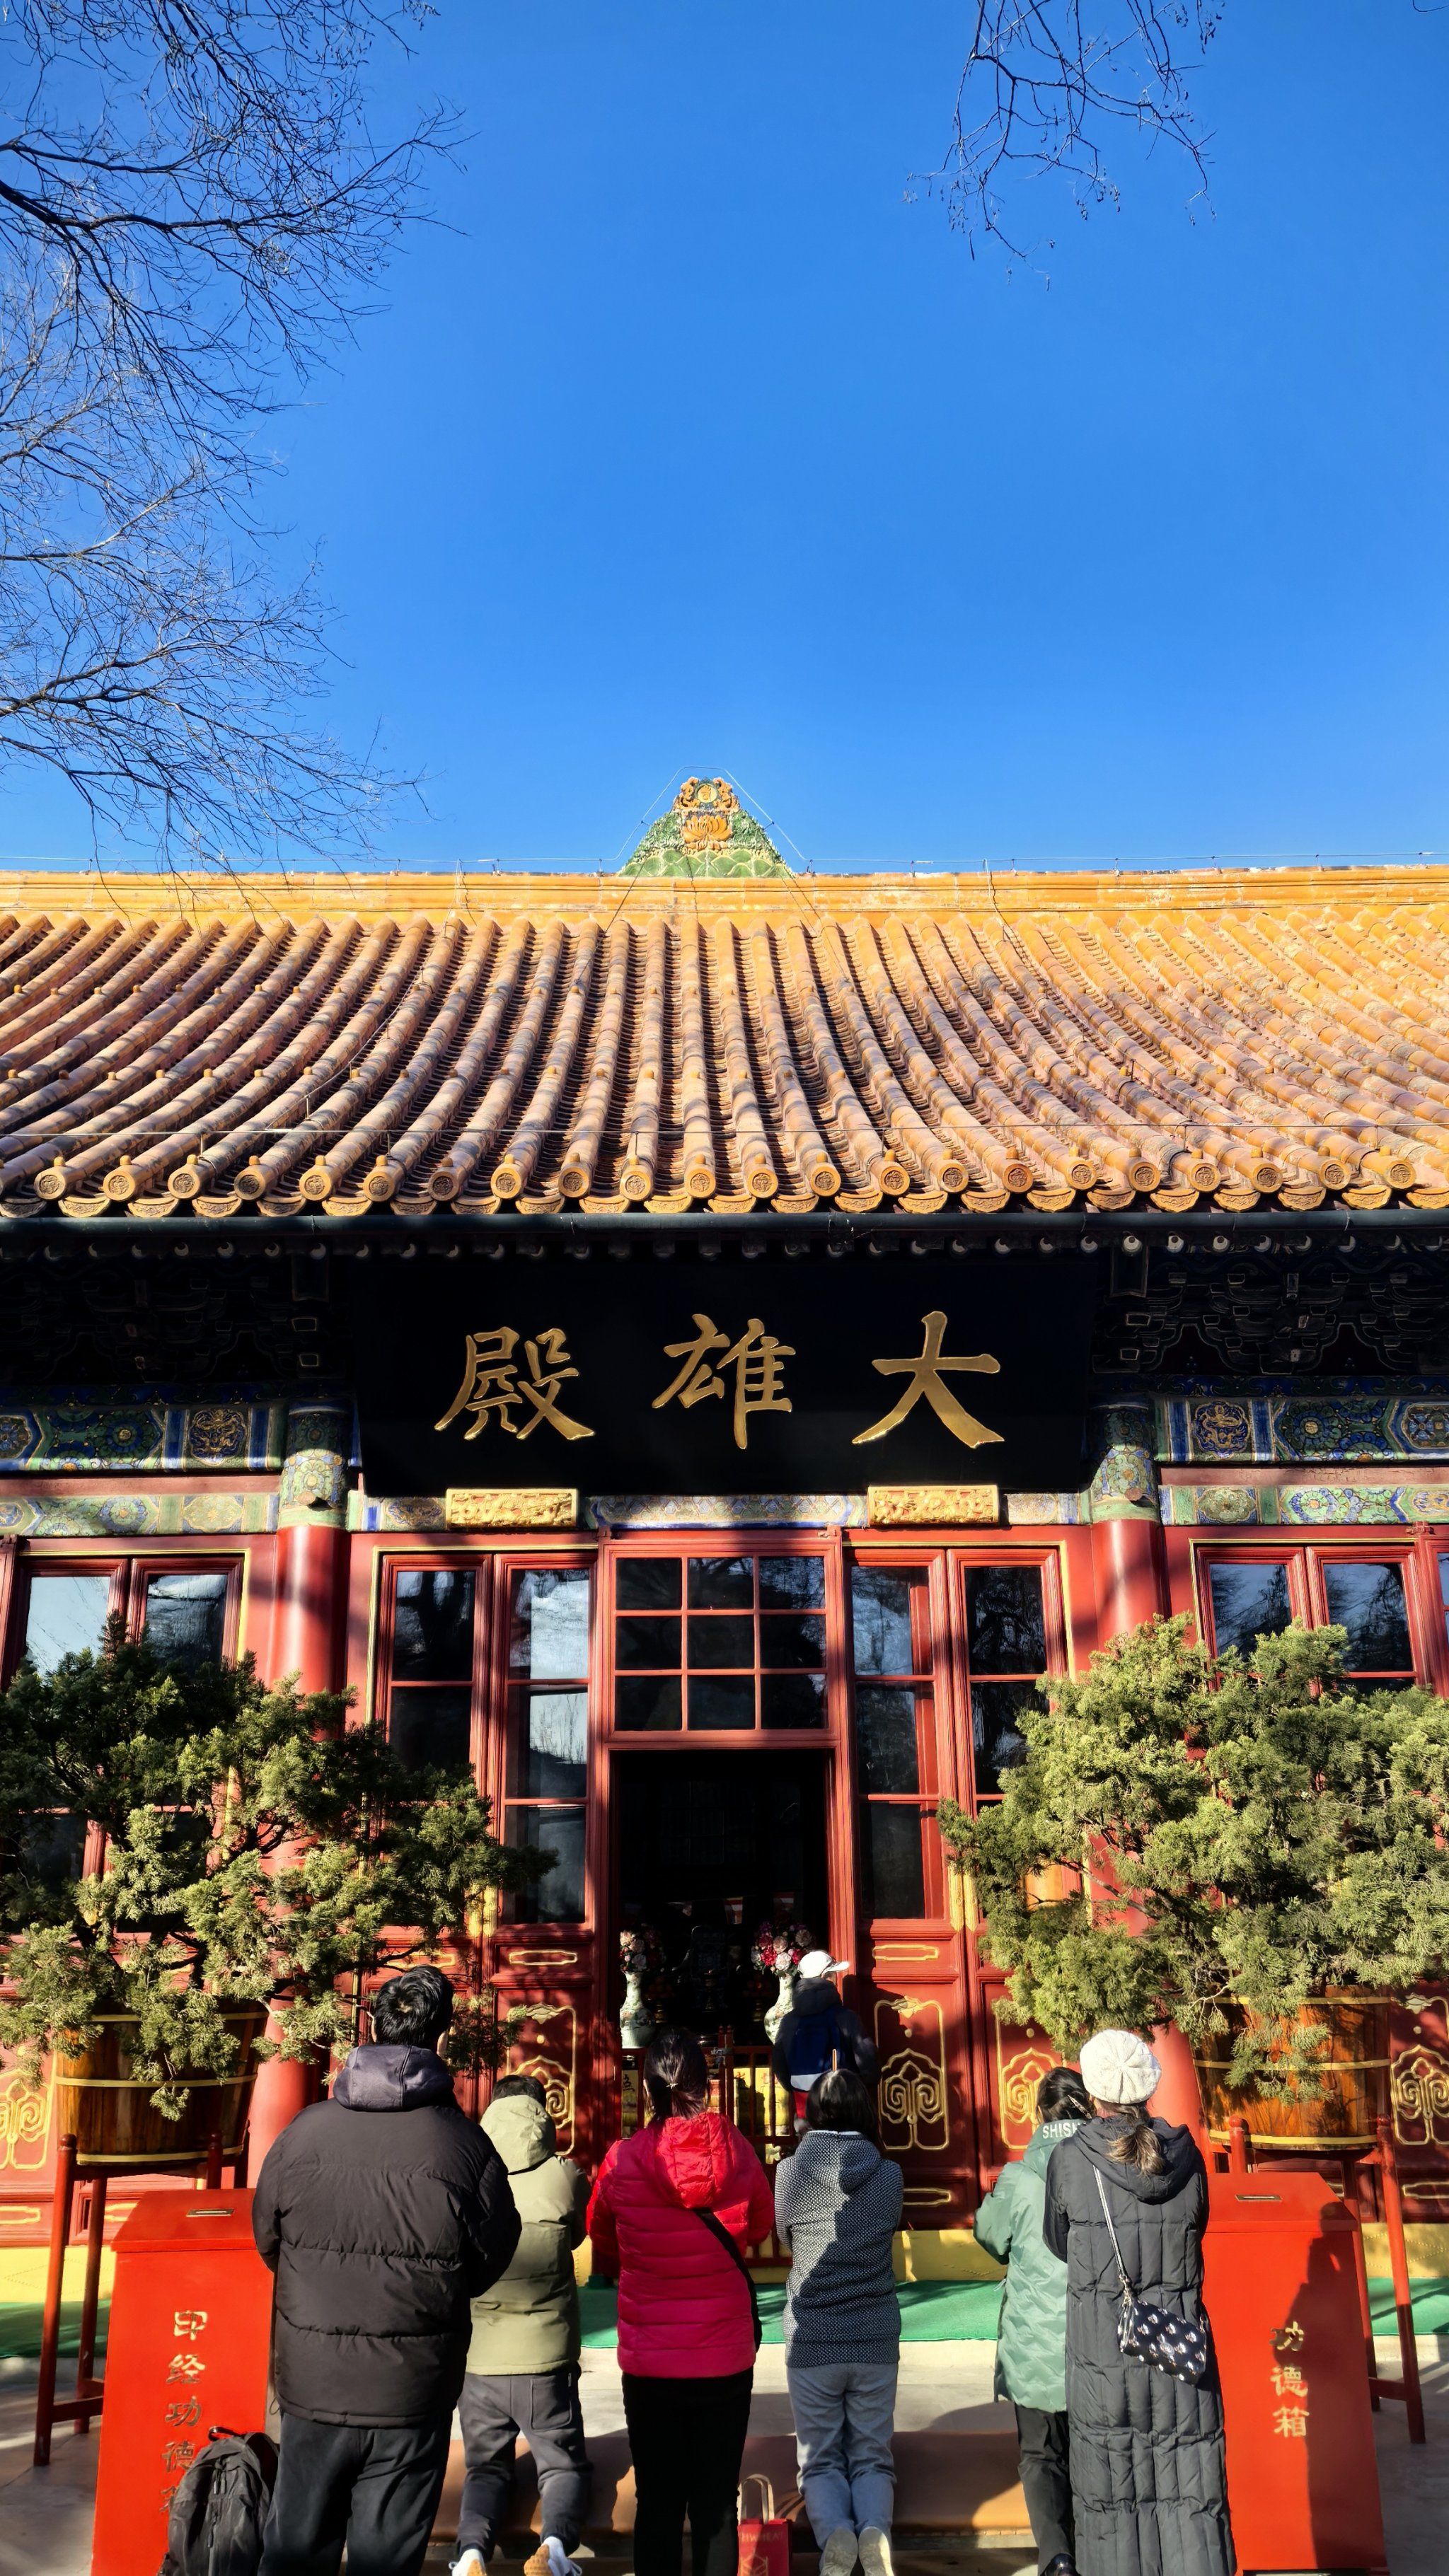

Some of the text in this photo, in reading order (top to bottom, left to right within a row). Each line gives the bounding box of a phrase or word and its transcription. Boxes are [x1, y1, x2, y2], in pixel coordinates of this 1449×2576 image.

[433, 1309, 1005, 1450] 大雄殿
[1269, 2320, 1310, 2438] 功德箱
